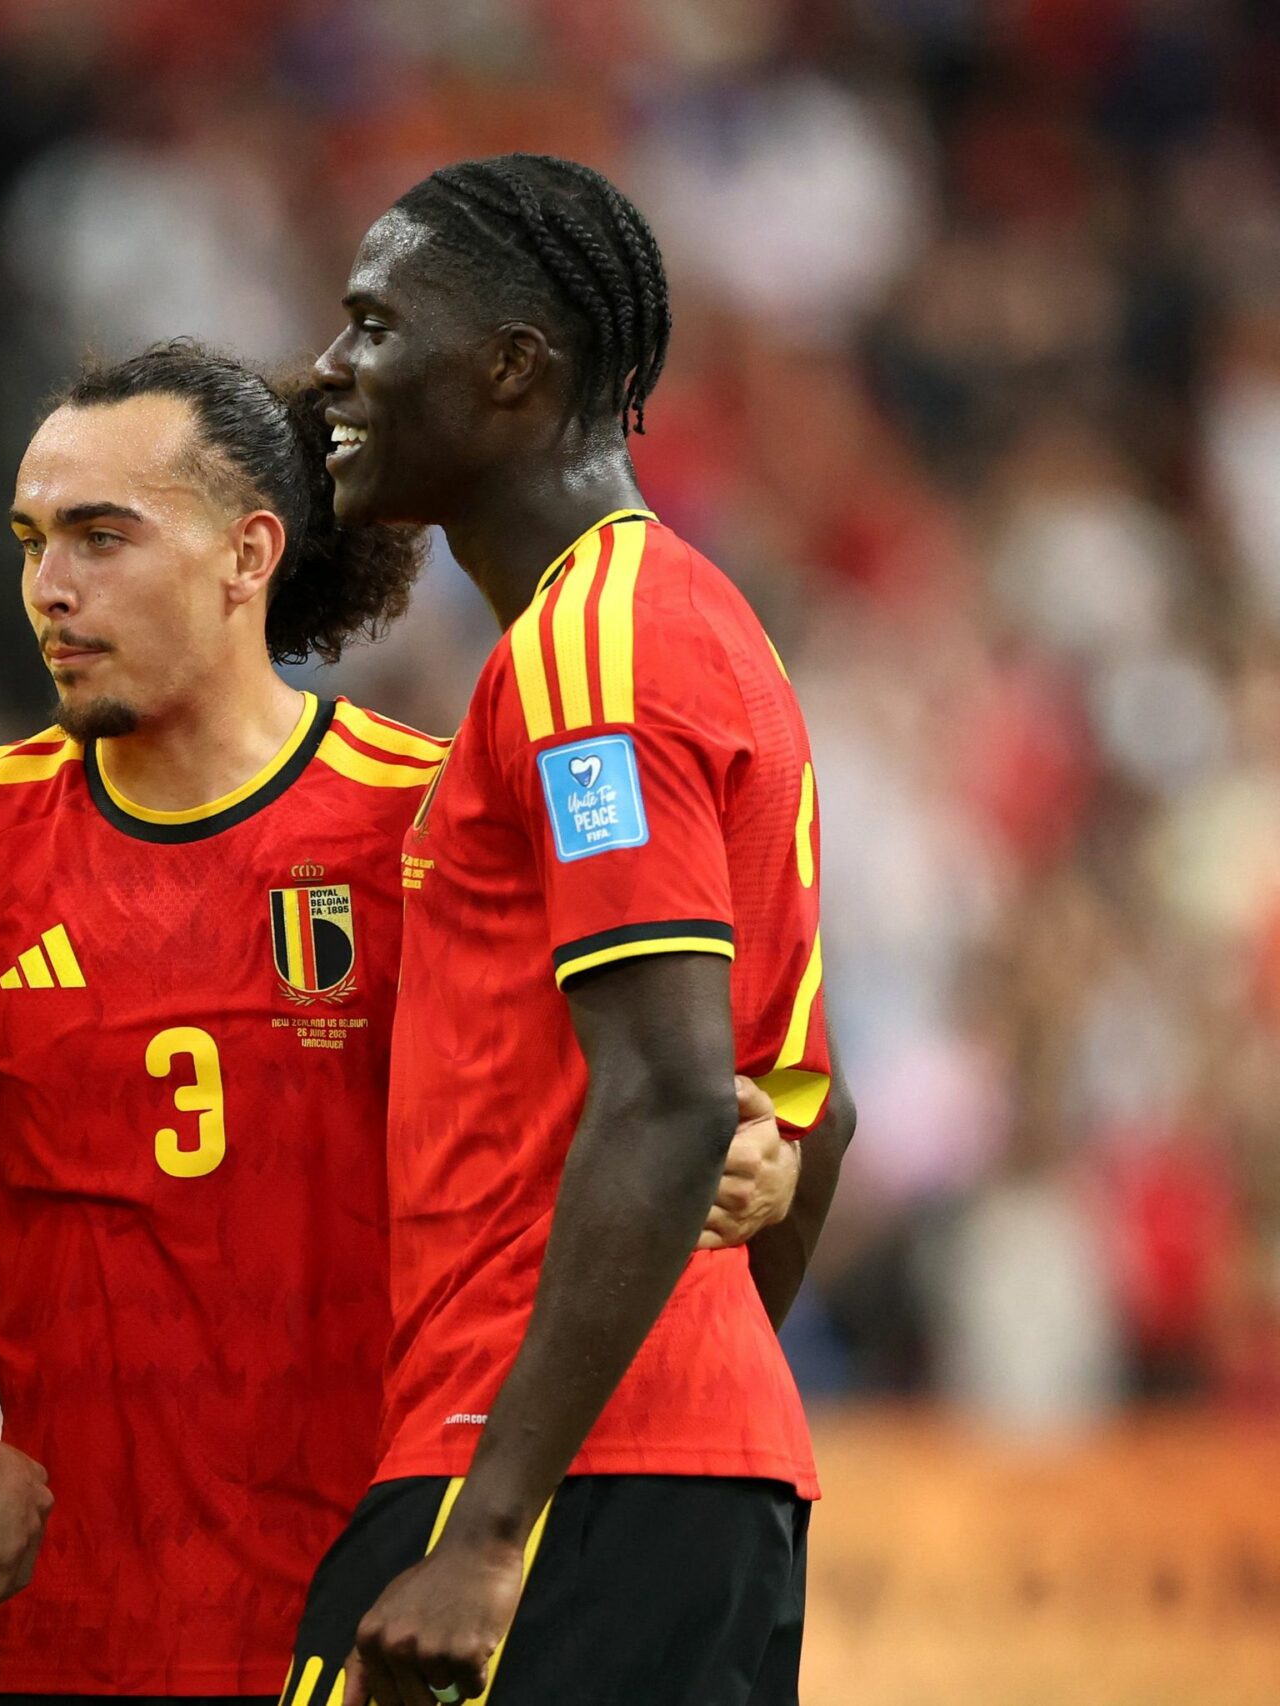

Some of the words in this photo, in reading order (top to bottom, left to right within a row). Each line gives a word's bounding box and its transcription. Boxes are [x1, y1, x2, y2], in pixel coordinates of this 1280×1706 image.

[568, 791, 597, 813] Unite
[596, 784, 617, 805] For
[574, 804, 619, 833] PEACE
[586, 828, 609, 842] FIFA
[310, 888, 338, 898] ROYAL
[311, 896, 349, 907] BELGIAN
[271, 1018, 289, 1028] NEW
[291, 1018, 325, 1028] ZEALAND
[338, 1018, 368, 1028] BELGIUM
[297, 1028, 307, 1037] 26
[309, 1029, 327, 1038] JUNE
[328, 1029, 347, 1039] 2026
[301, 1038, 344, 1049] VANCOUVER
[145, 1026, 226, 1178] 3
